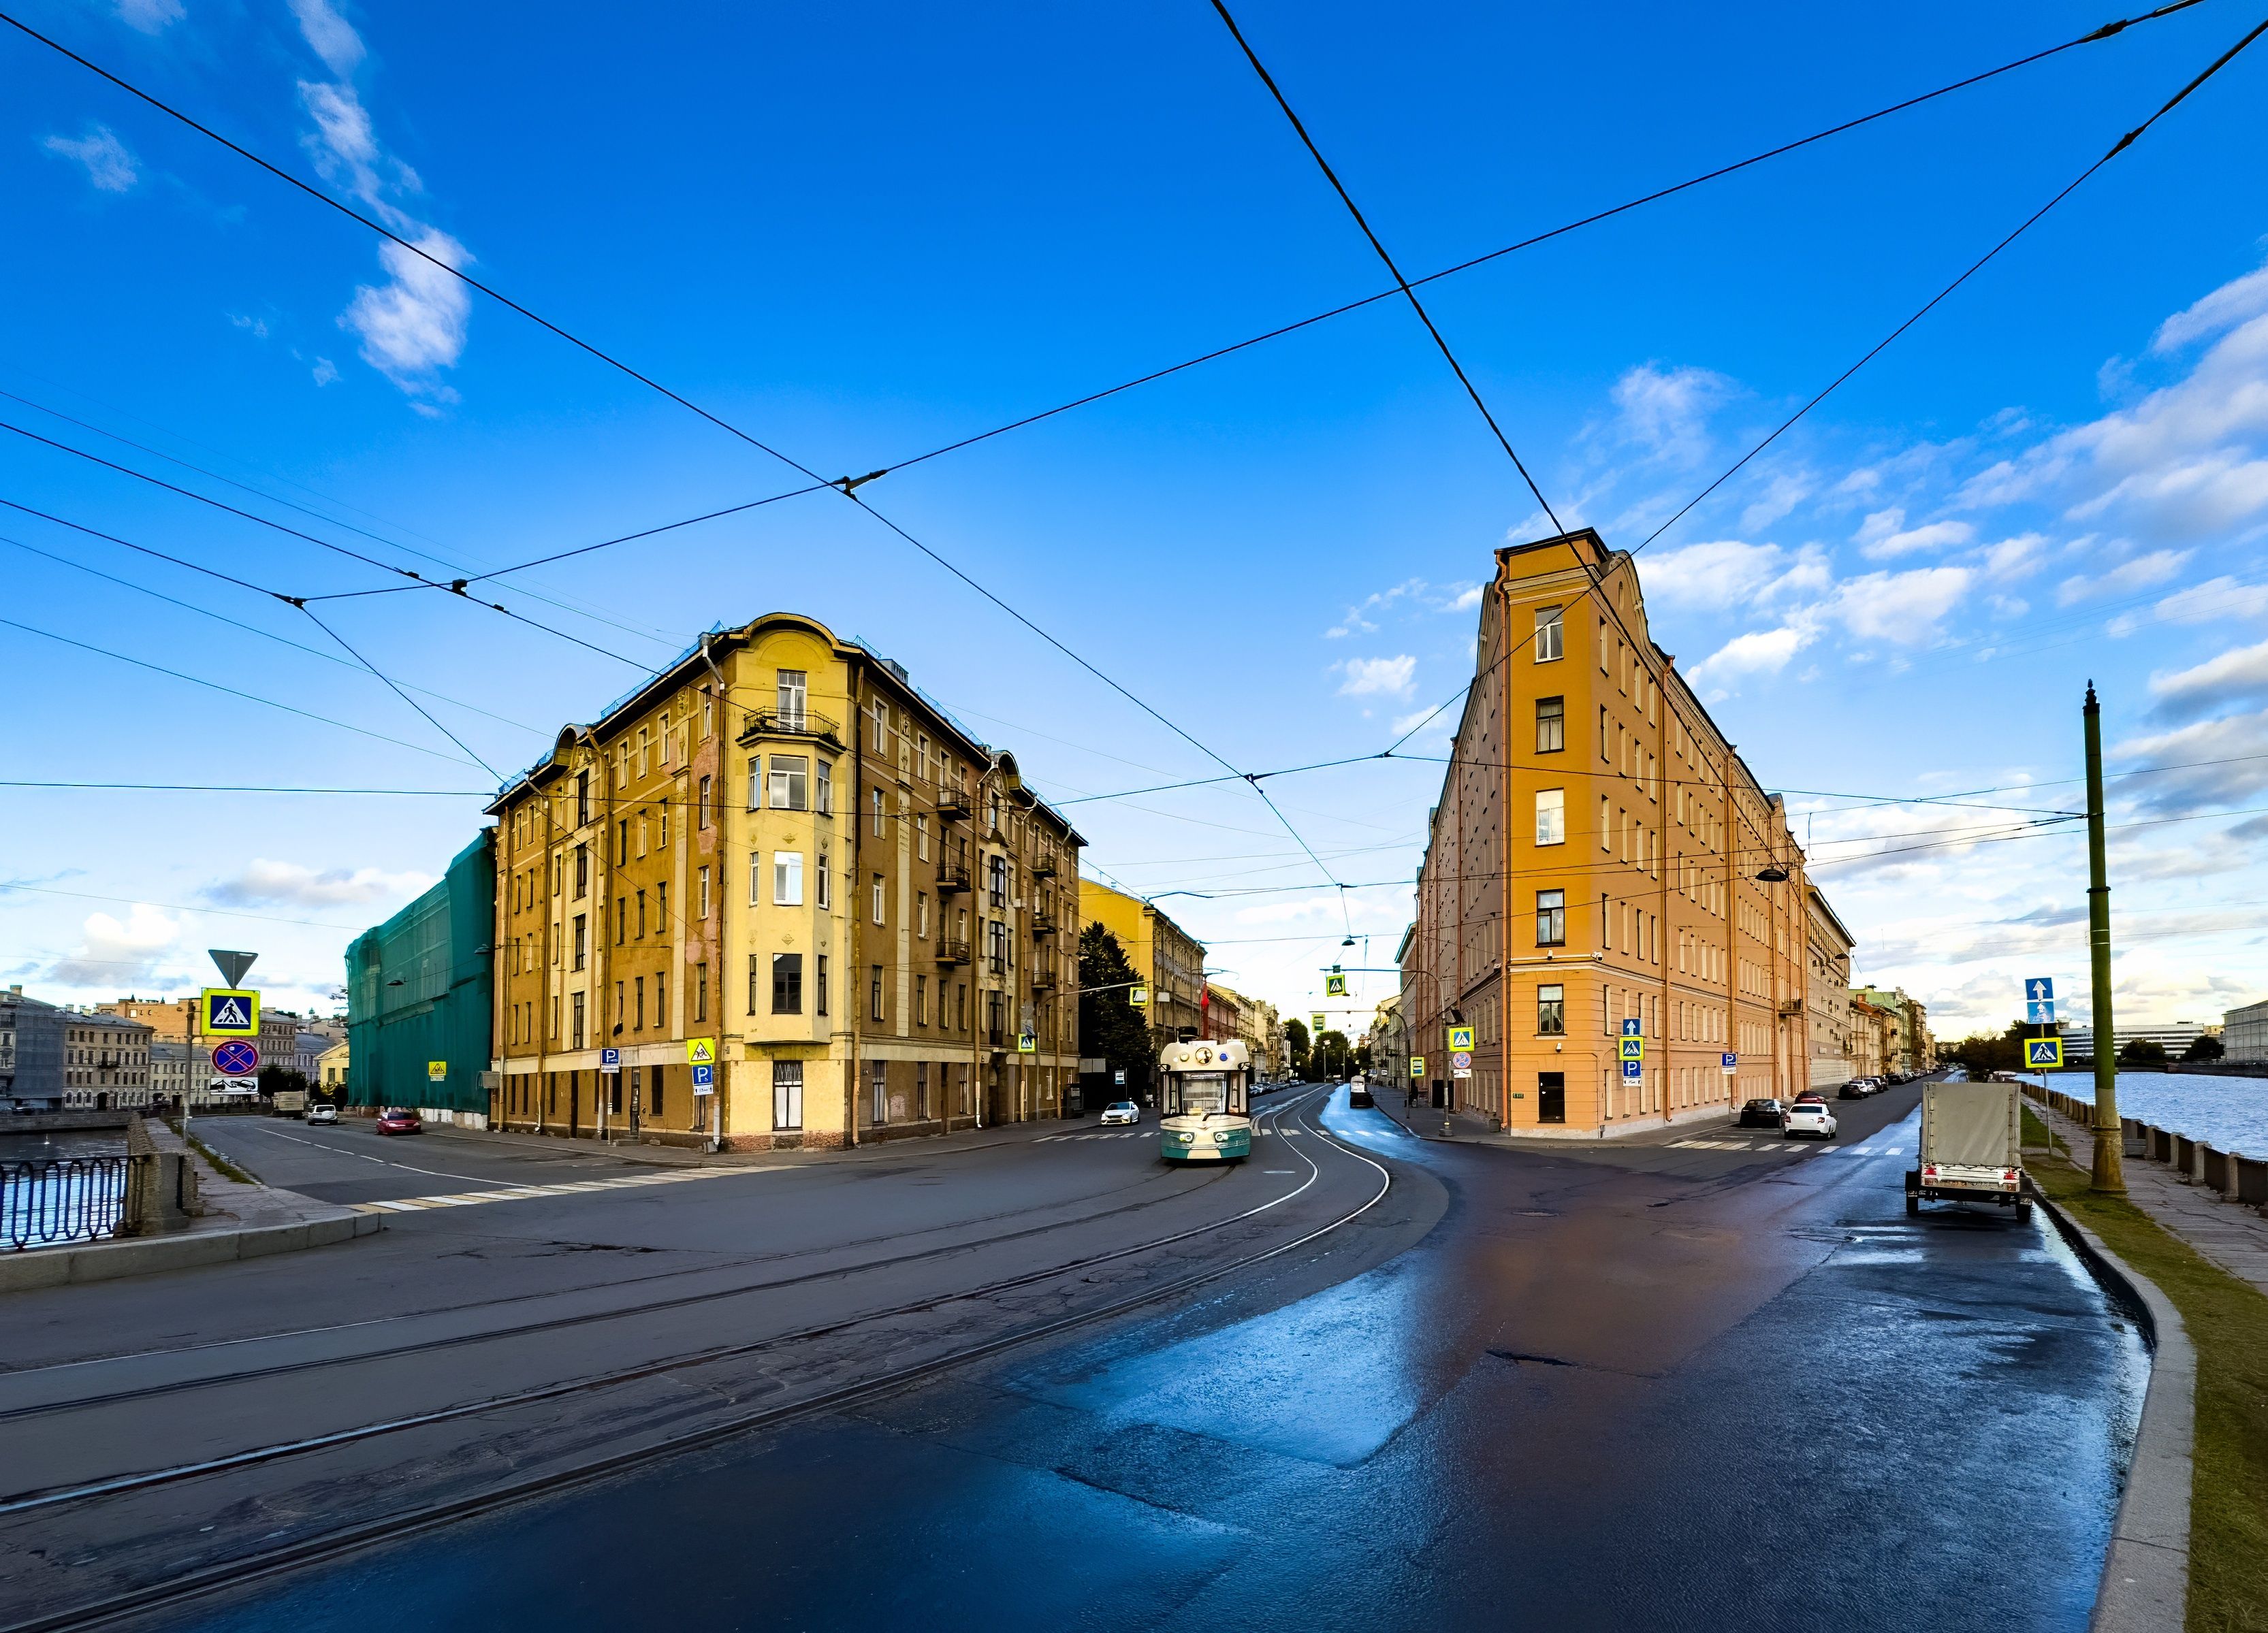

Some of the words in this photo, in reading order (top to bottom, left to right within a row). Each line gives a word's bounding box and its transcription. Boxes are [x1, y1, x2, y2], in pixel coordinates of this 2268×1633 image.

[606, 1050, 616, 1063] P
[1726, 1054, 1734, 1065] P
[697, 1067, 708, 1082] P
[1627, 1061, 1638, 1076] P
